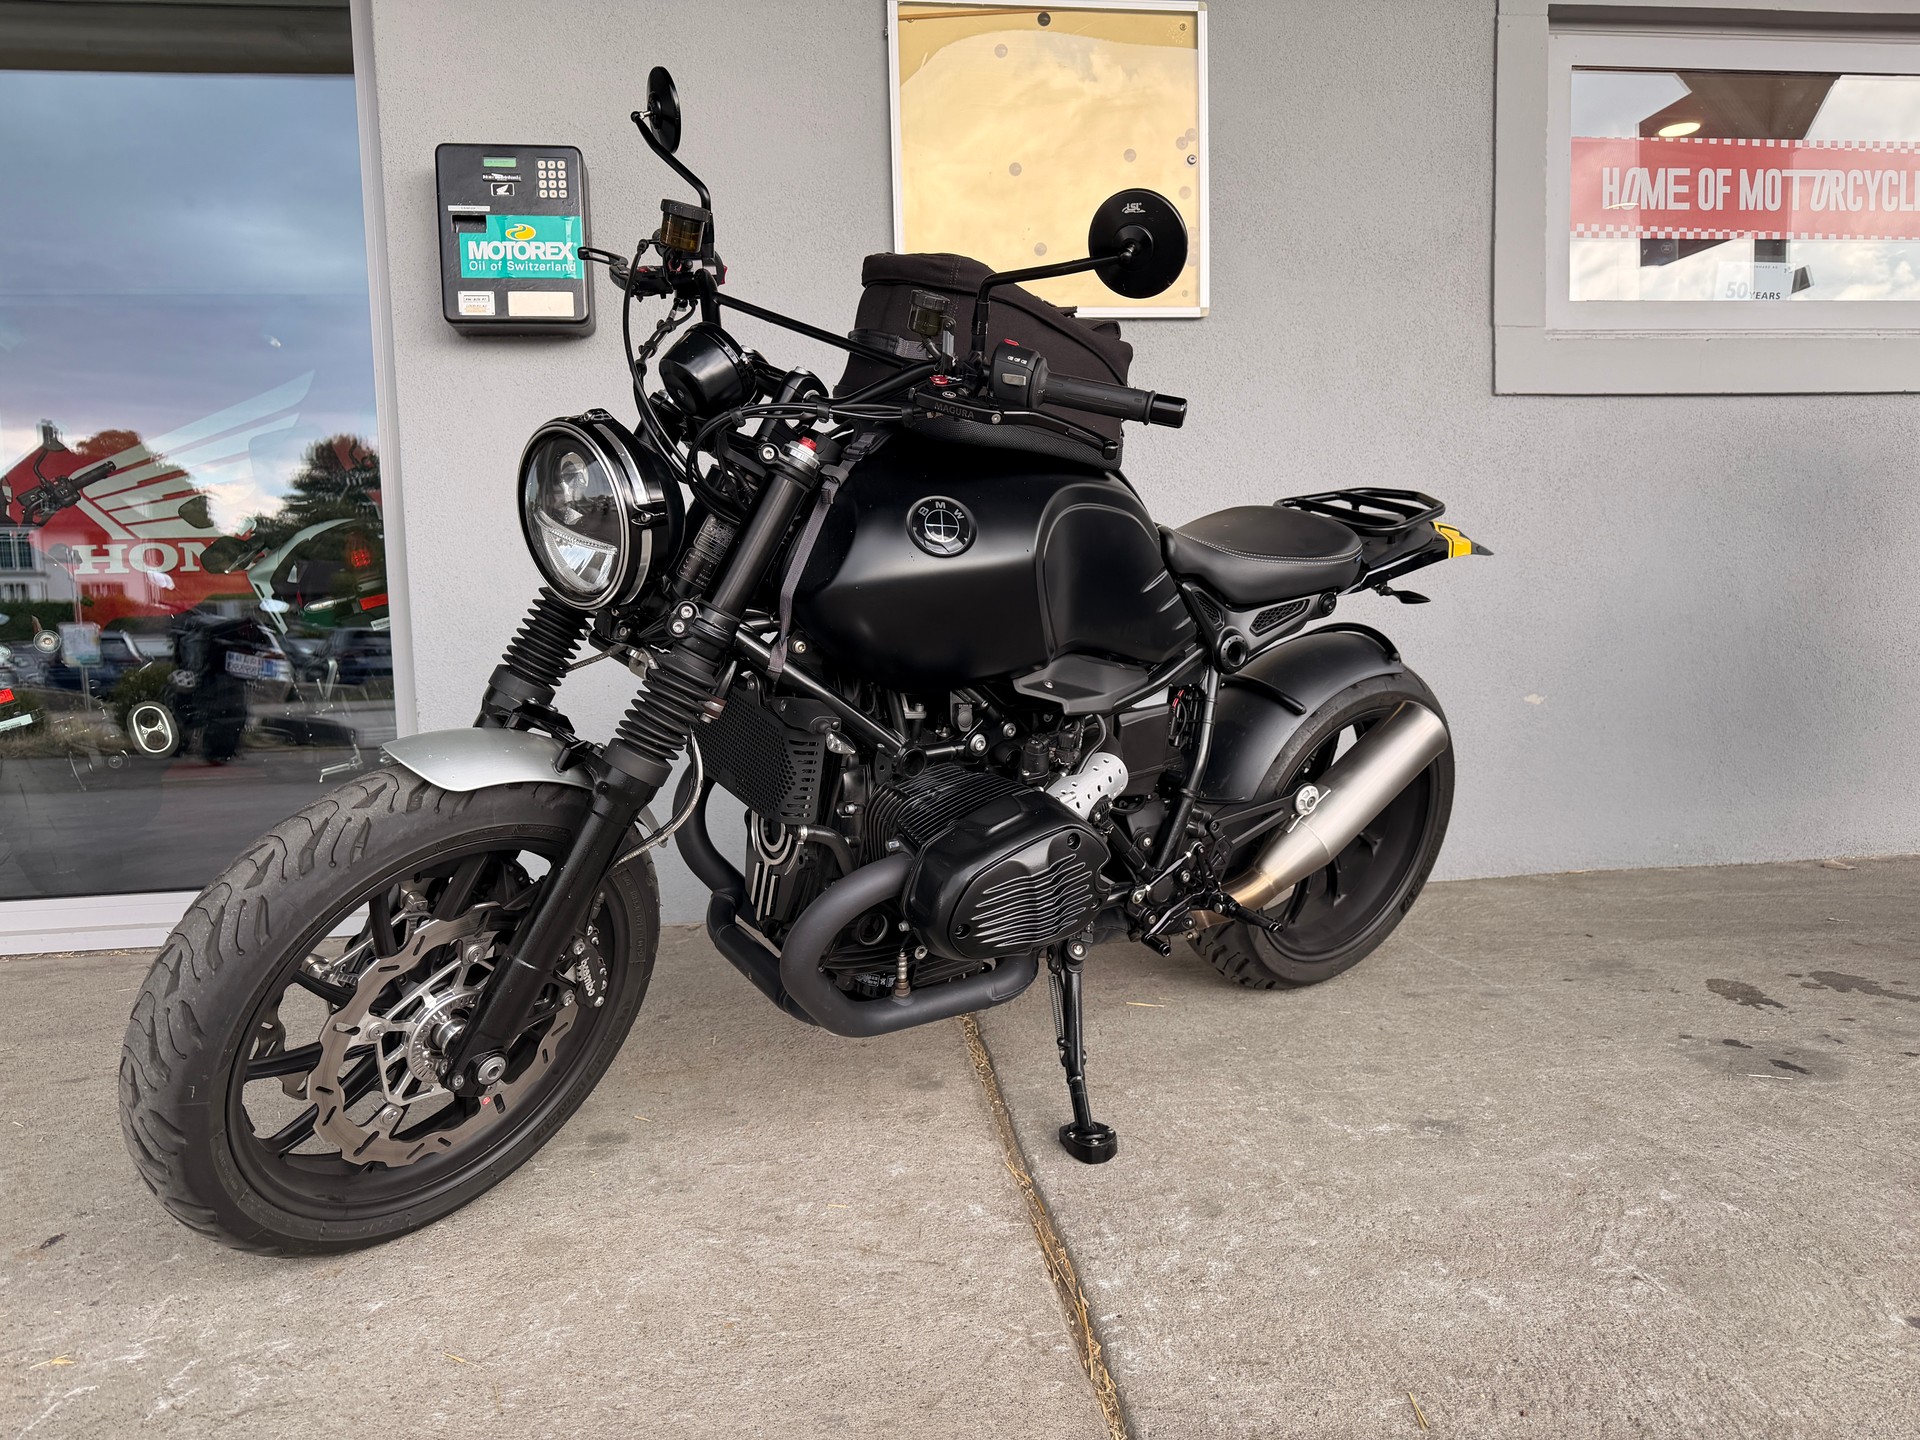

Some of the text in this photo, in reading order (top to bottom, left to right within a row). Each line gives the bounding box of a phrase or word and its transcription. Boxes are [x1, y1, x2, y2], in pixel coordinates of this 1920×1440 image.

[1602, 167, 1690, 210] HOME
[1698, 168, 1732, 211] OF
[468, 240, 575, 260] MOTOREX
[469, 261, 576, 272] Oil of Switzerland
[1725, 281, 1781, 300] 50 YEARS
[934, 402, 974, 419] MAGURA
[918, 501, 965, 520] BMW
